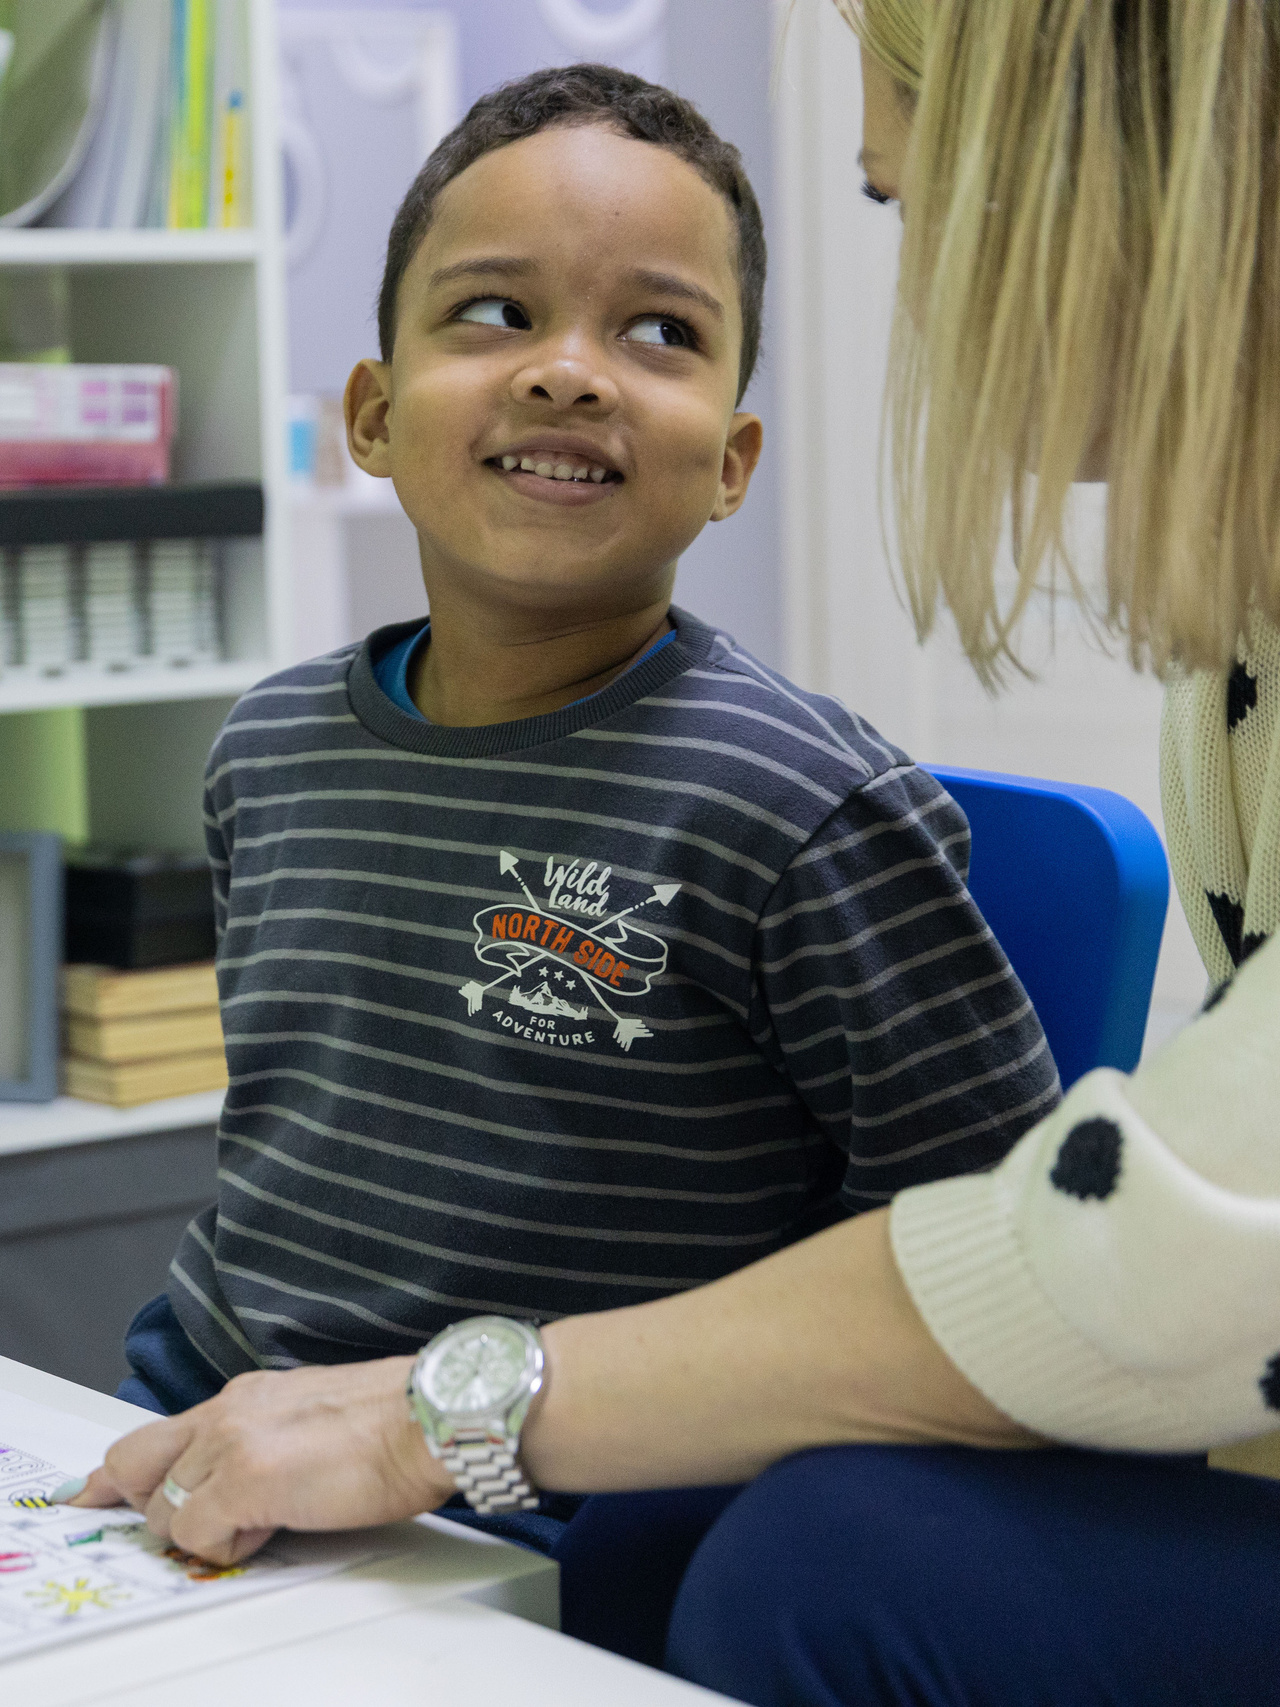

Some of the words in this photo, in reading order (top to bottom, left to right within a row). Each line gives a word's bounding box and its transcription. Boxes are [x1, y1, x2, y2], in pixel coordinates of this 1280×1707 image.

[544, 856, 612, 896] Wild
[548, 883, 609, 917] Land
[492, 912, 575, 954] NORTH
[573, 940, 630, 986] SIDE
[491, 1010, 596, 1046] ADVENTURE
[529, 1015, 556, 1030] FOR
